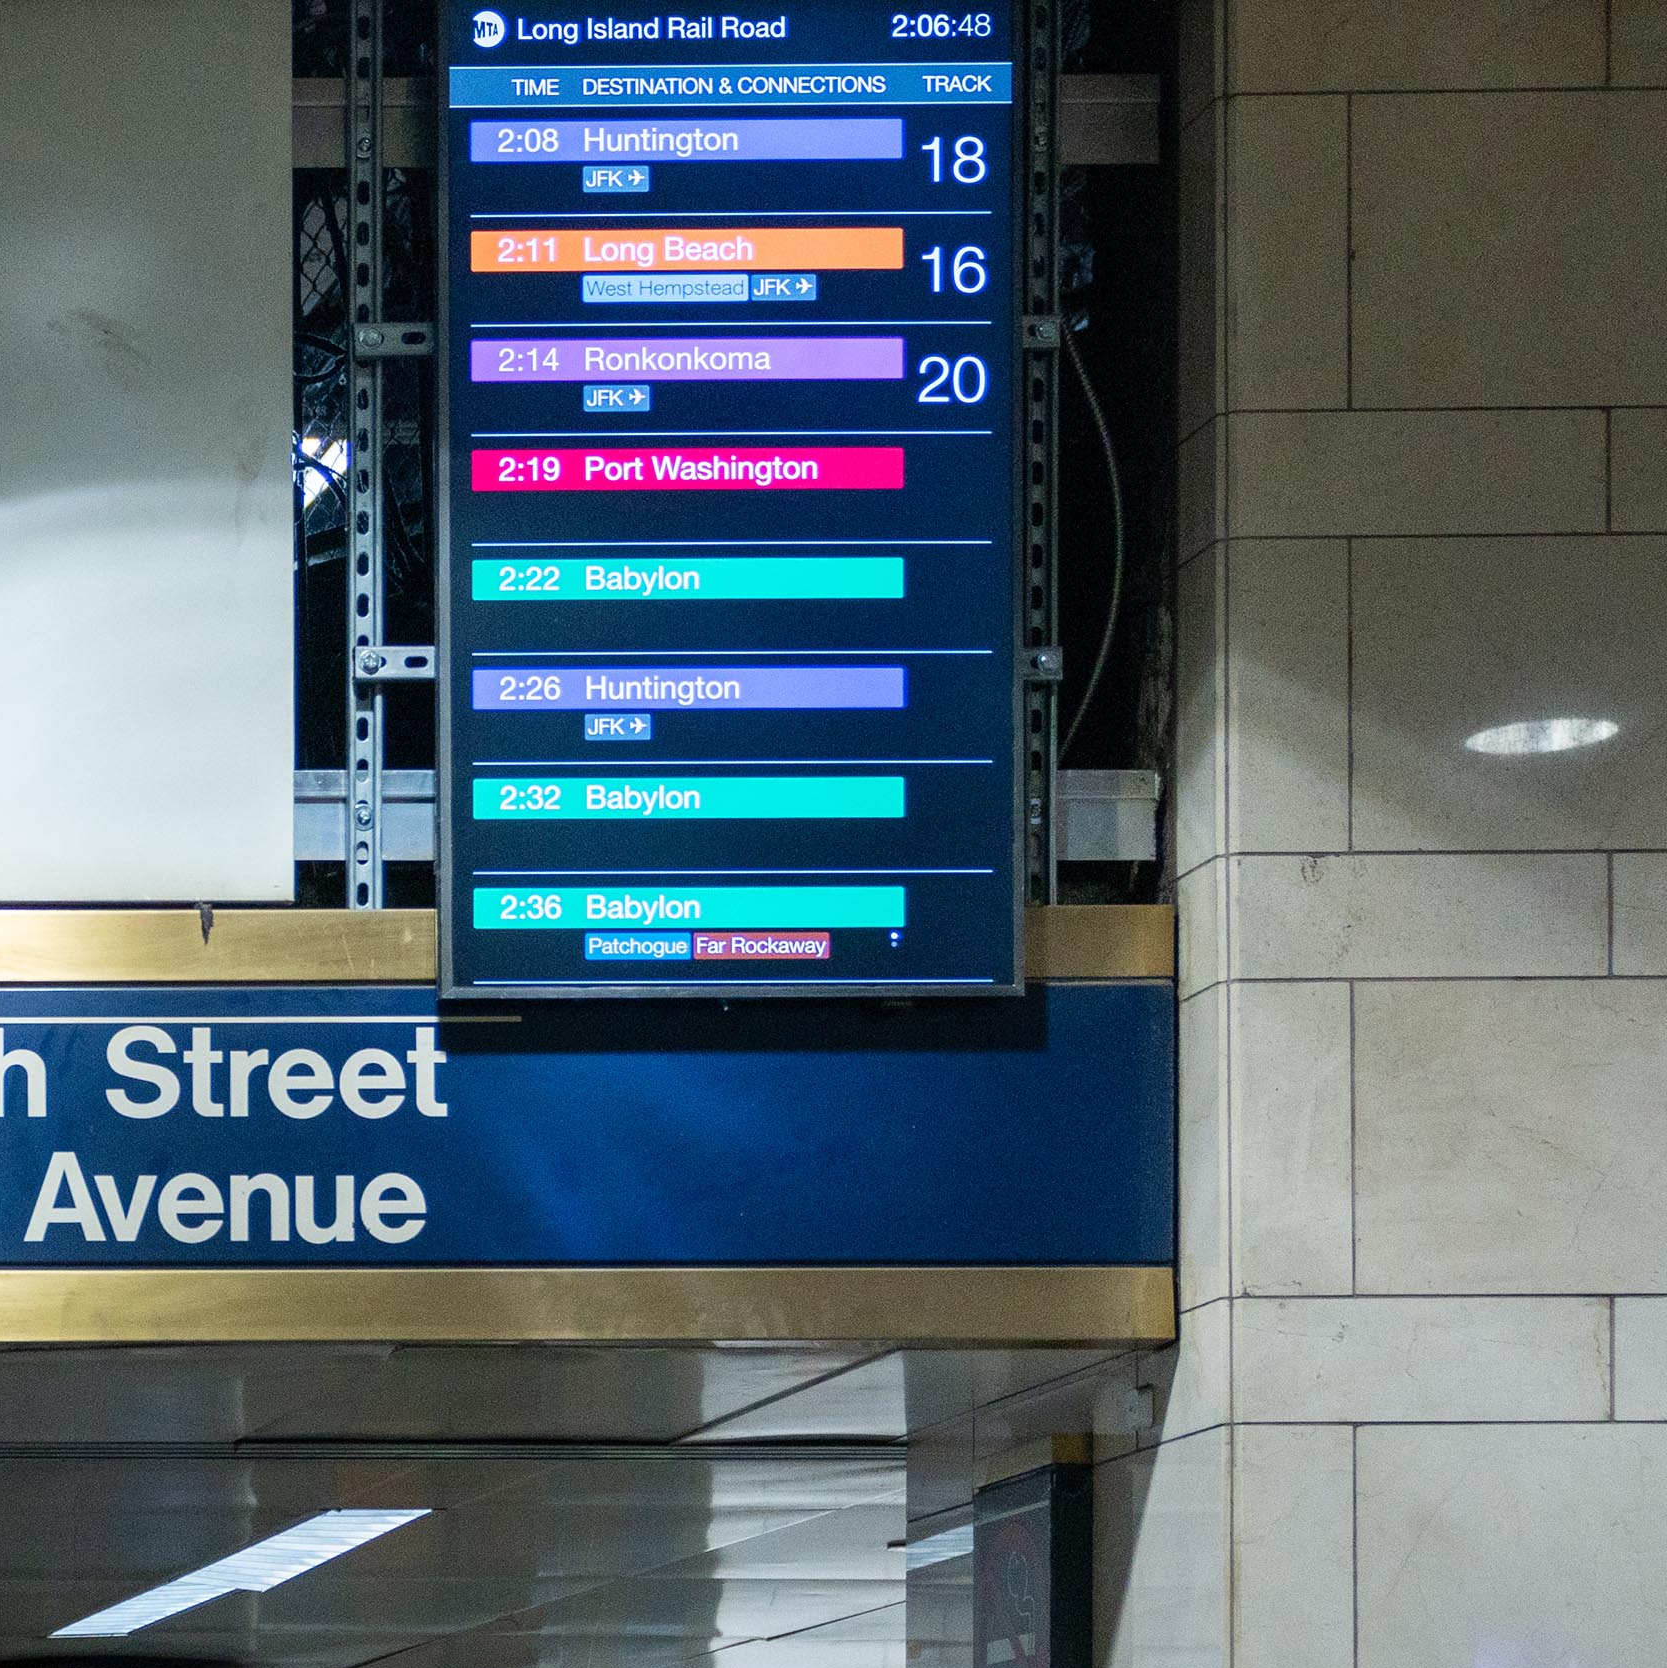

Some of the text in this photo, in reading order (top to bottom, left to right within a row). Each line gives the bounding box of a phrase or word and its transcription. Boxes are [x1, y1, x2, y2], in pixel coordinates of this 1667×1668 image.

[517, 18, 579, 42] Long
[587, 17, 658, 39] Island
[668, 17, 714, 39] Rail
[721, 16, 786, 38] Road
[892, 15, 991, 38] 2:06:48
[512, 75, 992, 96] TIME DESTINATION & CONNECTIONS TRACK
[498, 128, 739, 158] 2:08 Huntington
[921, 136, 986, 183] 18
[585, 170, 623, 188] JFK
[498, 236, 753, 267] 2:11 Long Beach
[921, 245, 986, 293] 16
[587, 279, 744, 301] West Hempstead
[754, 278, 791, 296] JFK
[498, 347, 771, 372] 2:14 Ronkonkoma
[918, 355, 986, 403] 20
[586, 389, 624, 407] JFK
[498, 455, 818, 486] 2:19 Port Washington
[498, 566, 700, 597] 2:22 Babylon
[499, 676, 740, 705] 2:26 Huntington
[587, 717, 625, 736] JFK
[499, 785, 701, 816] 2:32 Babylon
[499, 894, 701, 925] 2:36 Babylon
[588, 937, 688, 959] Patchogue
[696, 936, 826, 958] Far Rockaway
[104, 1027, 450, 1120] Street
[23, 1152, 428, 1244] Avenue
